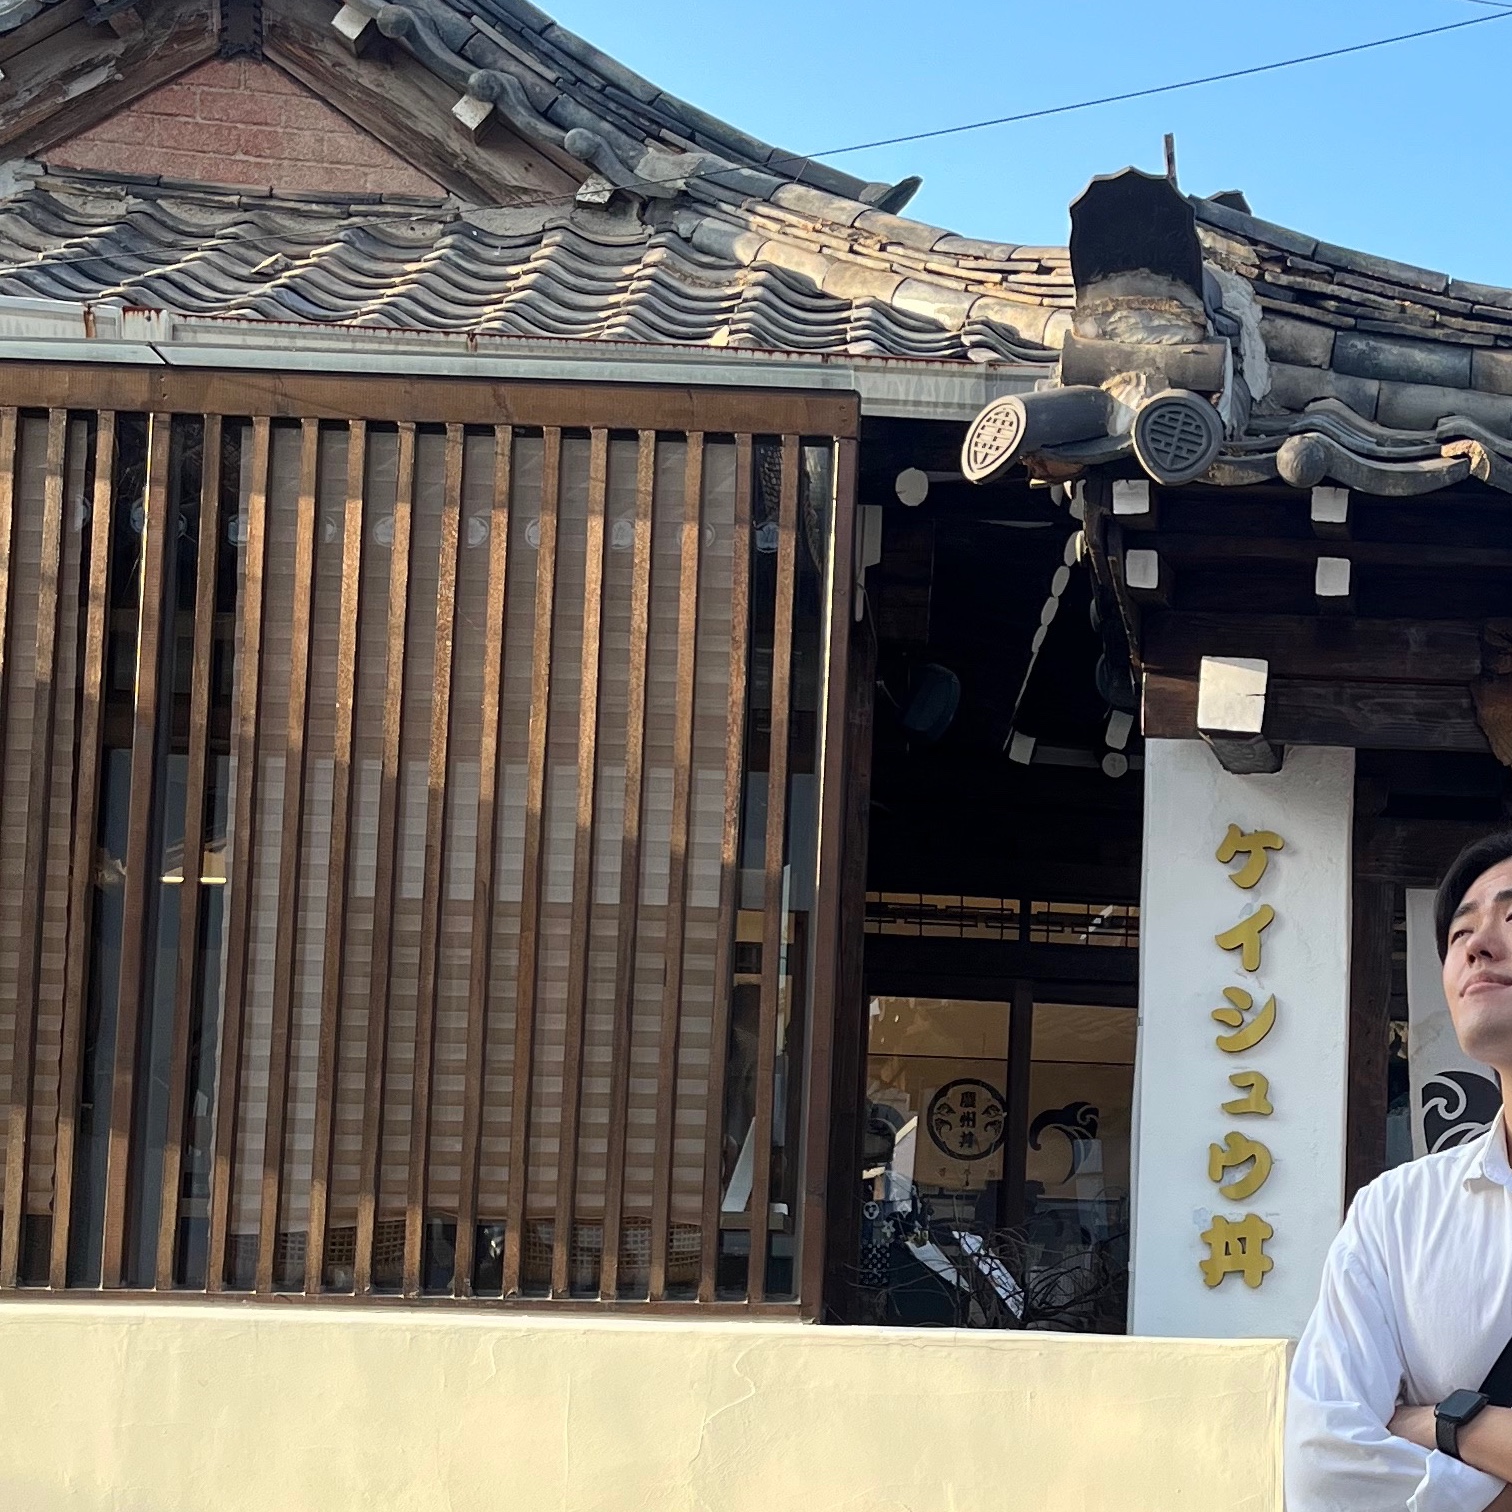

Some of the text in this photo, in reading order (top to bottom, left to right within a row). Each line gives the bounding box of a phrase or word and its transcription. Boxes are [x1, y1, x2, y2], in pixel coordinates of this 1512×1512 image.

[1199, 823, 1285, 1290] ケイシュウ丼
